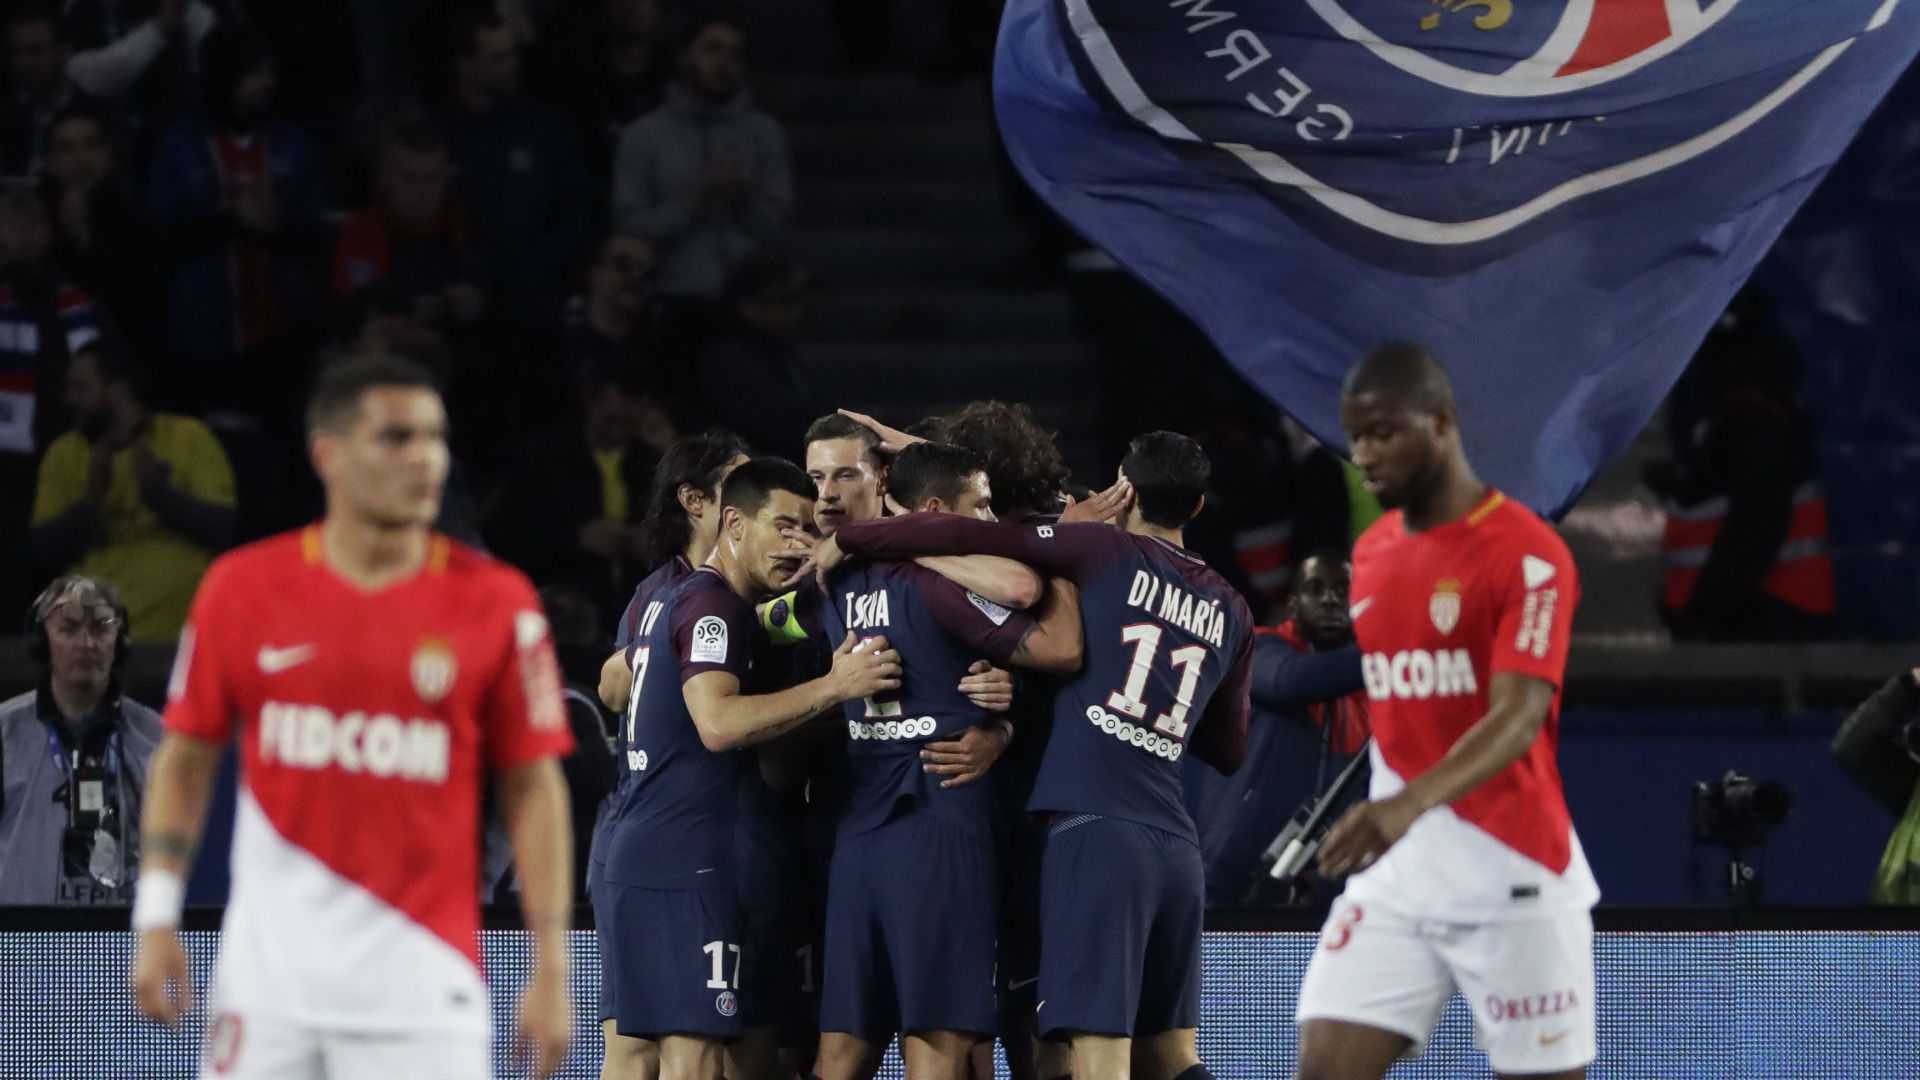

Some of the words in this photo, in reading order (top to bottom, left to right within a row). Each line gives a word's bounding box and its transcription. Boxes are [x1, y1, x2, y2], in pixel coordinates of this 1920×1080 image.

[1128, 569, 1158, 612] DI
[1158, 583, 1226, 648] MARÍA
[1106, 623, 1207, 738] 11
[1086, 704, 1183, 761] ooredoo
[702, 940, 740, 990] 17
